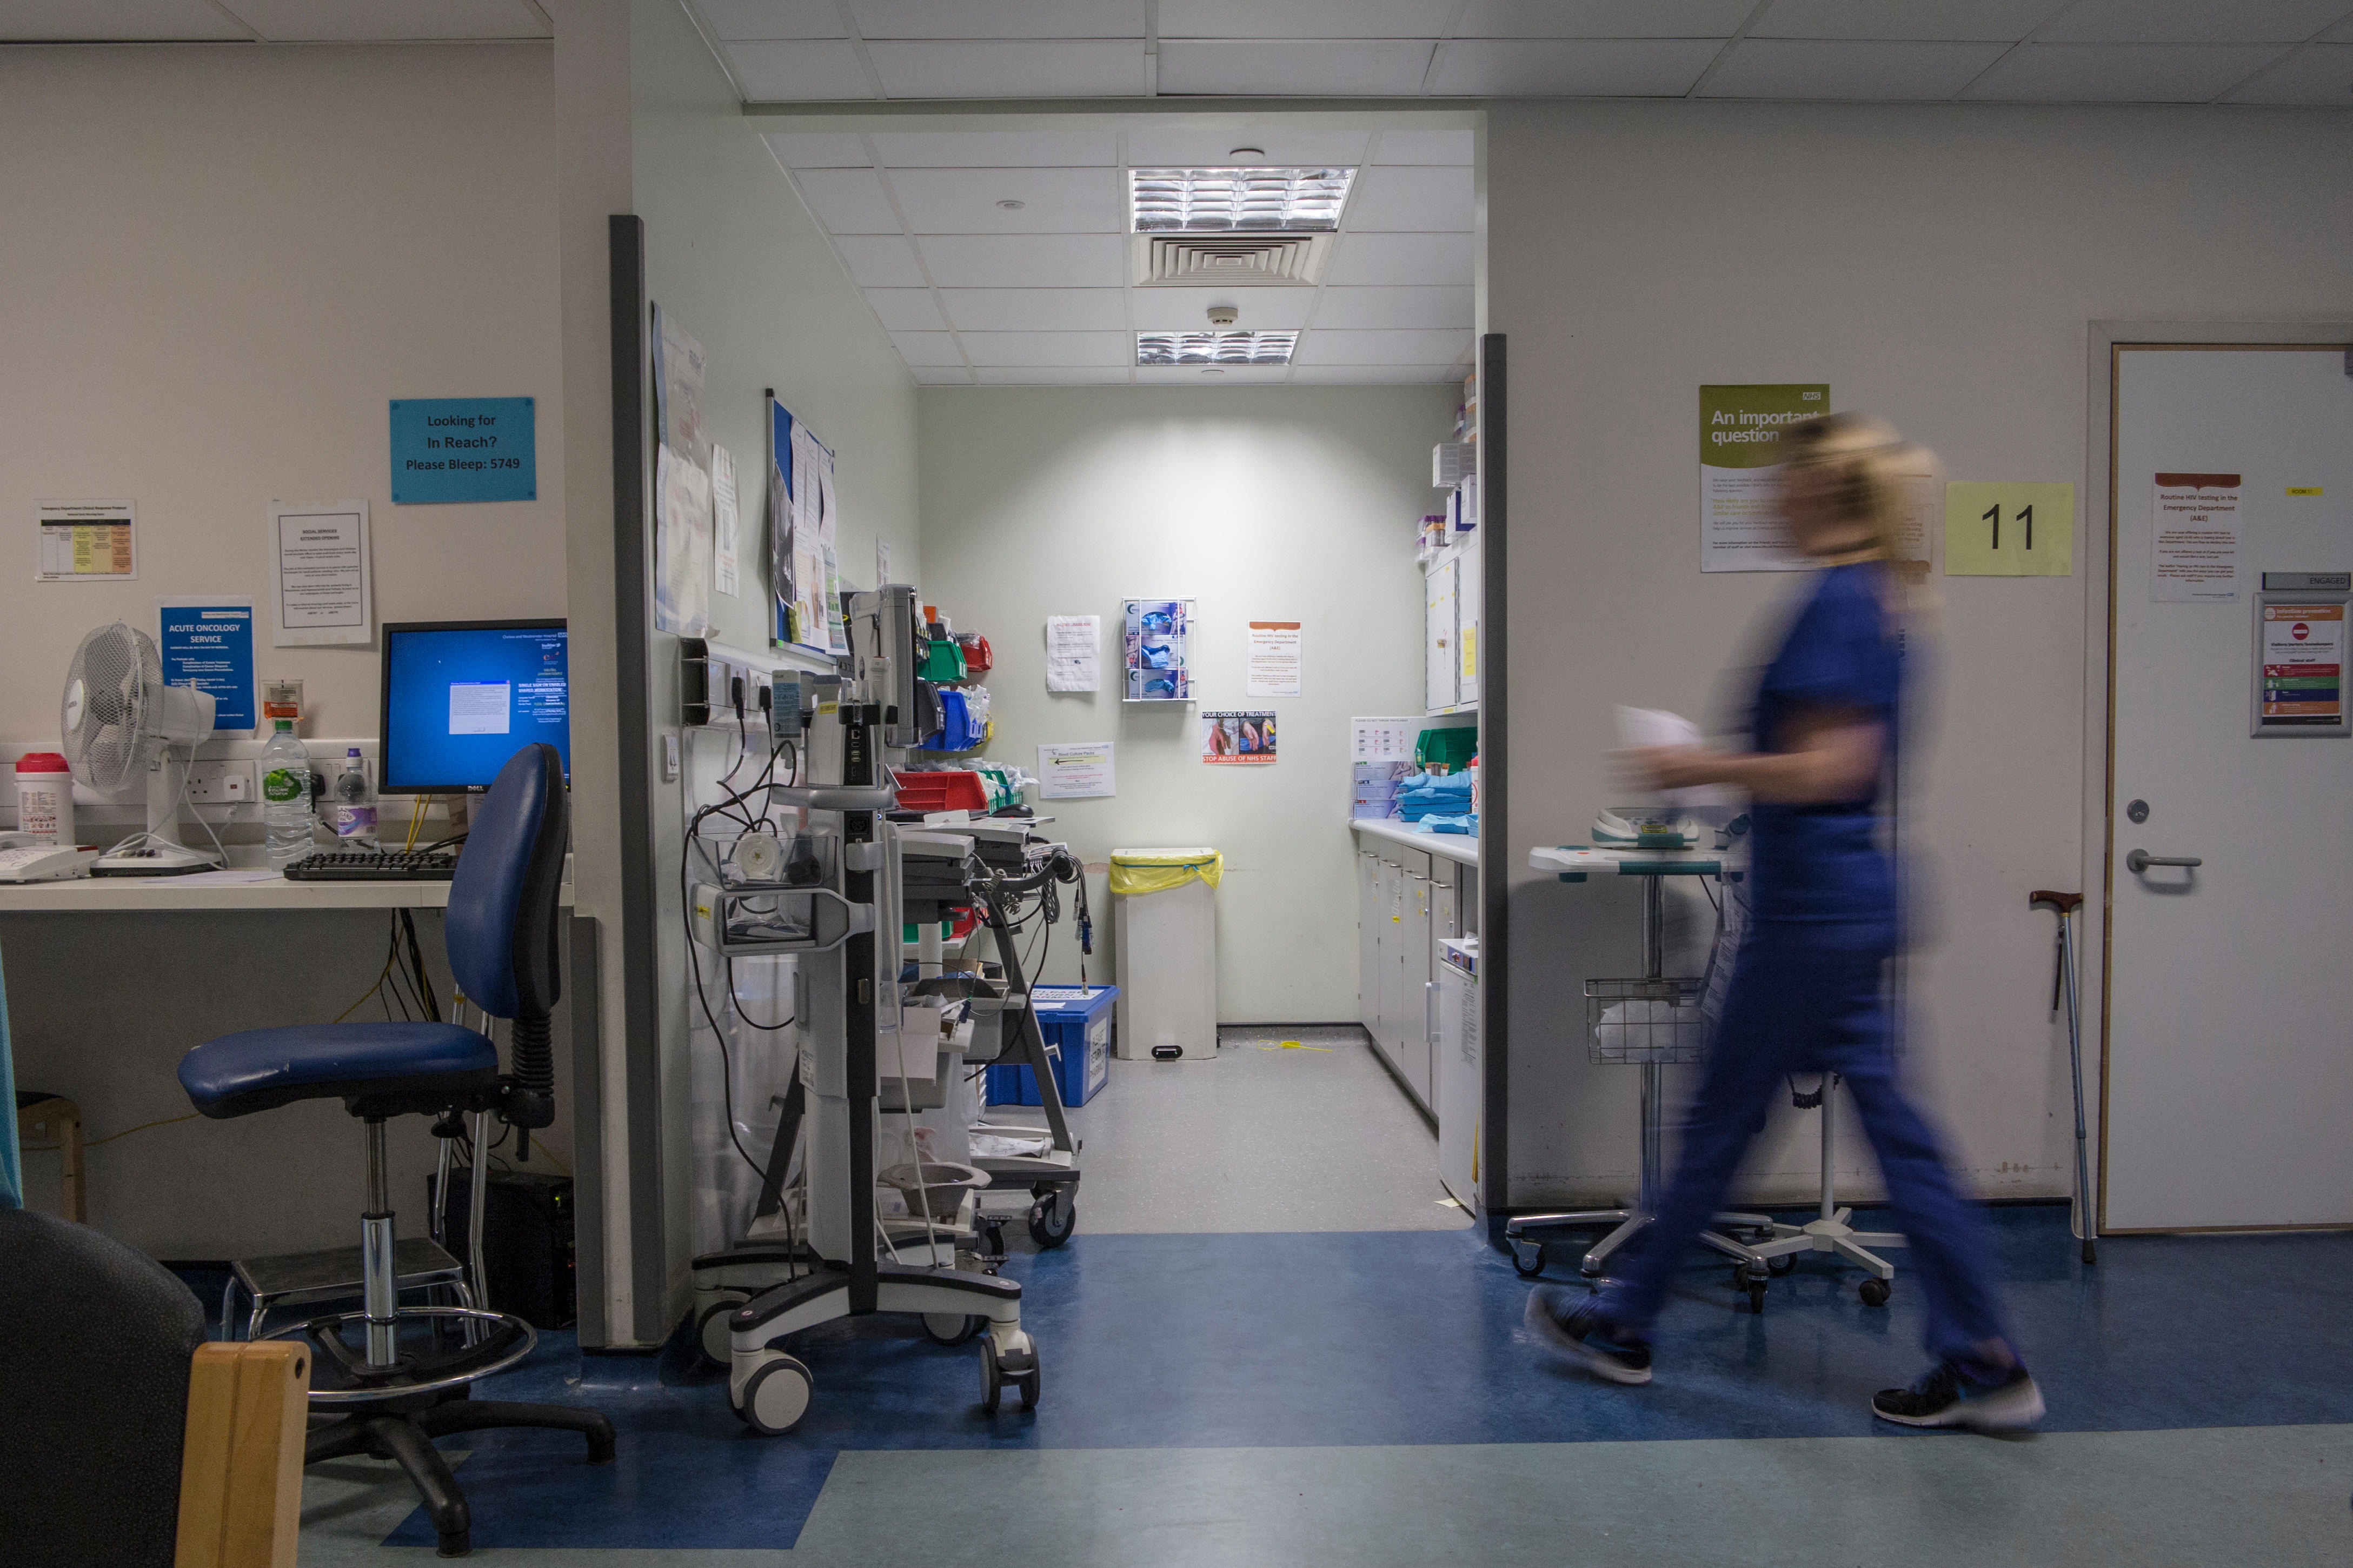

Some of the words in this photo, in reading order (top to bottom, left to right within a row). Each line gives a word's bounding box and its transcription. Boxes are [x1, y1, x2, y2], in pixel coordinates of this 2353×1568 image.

[428, 416, 474, 428] Looking
[478, 415, 496, 426] for
[1711, 410, 1734, 425] An
[427, 437, 440, 449] In
[445, 436, 497, 448] Reach?
[1712, 427, 1779, 446] question
[406, 459, 445, 470] Please
[449, 459, 487, 471] Bleep:
[490, 458, 520, 469] 5749
[1982, 504, 2032, 550] 11
[190, 635, 222, 643] SERVICE
